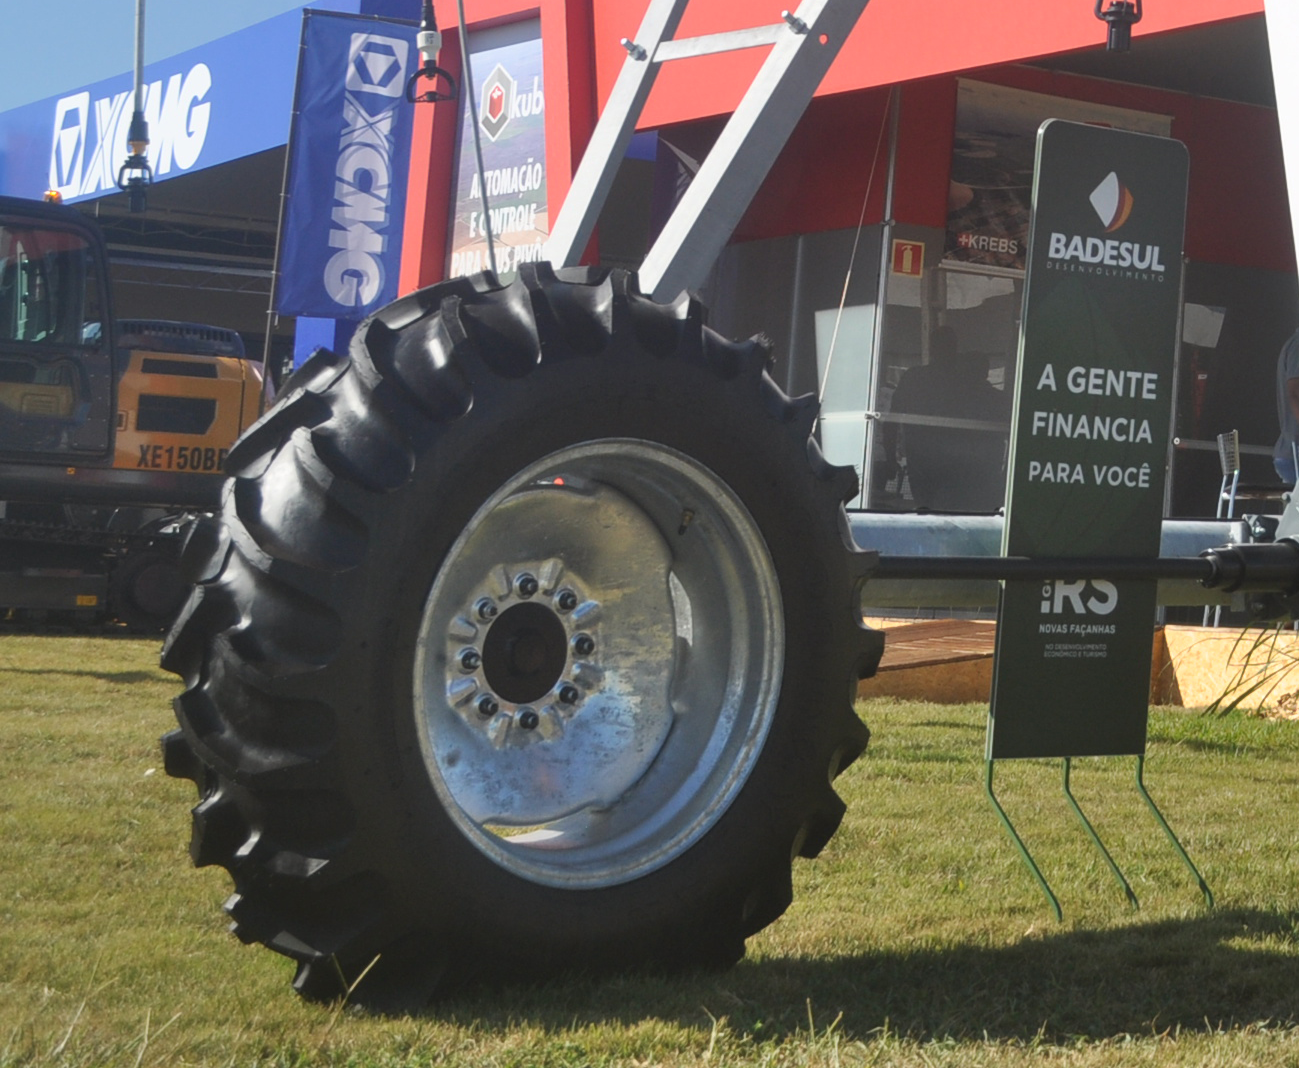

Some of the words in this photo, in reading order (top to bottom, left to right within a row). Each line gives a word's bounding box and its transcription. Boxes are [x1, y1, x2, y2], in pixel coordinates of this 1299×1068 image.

[469, 157, 543, 199] ATOMAÇÃO
[324, 89, 397, 307] XCMG
[469, 211, 477, 238] E
[1048, 232, 1165, 272] BADESUL
[1046, 261, 1165, 282] DESENVOLVIMENTO
[1036, 363, 1057, 392] A
[1066, 366, 1158, 400] GENTE
[1032, 411, 1153, 444] FINANCIA
[1028, 461, 1085, 484] PARA
[1093, 462, 1151, 488] VOCÊ
[1039, 624, 1068, 634] NOVAS
[1069, 624, 1116, 637] FAÇANHAS
